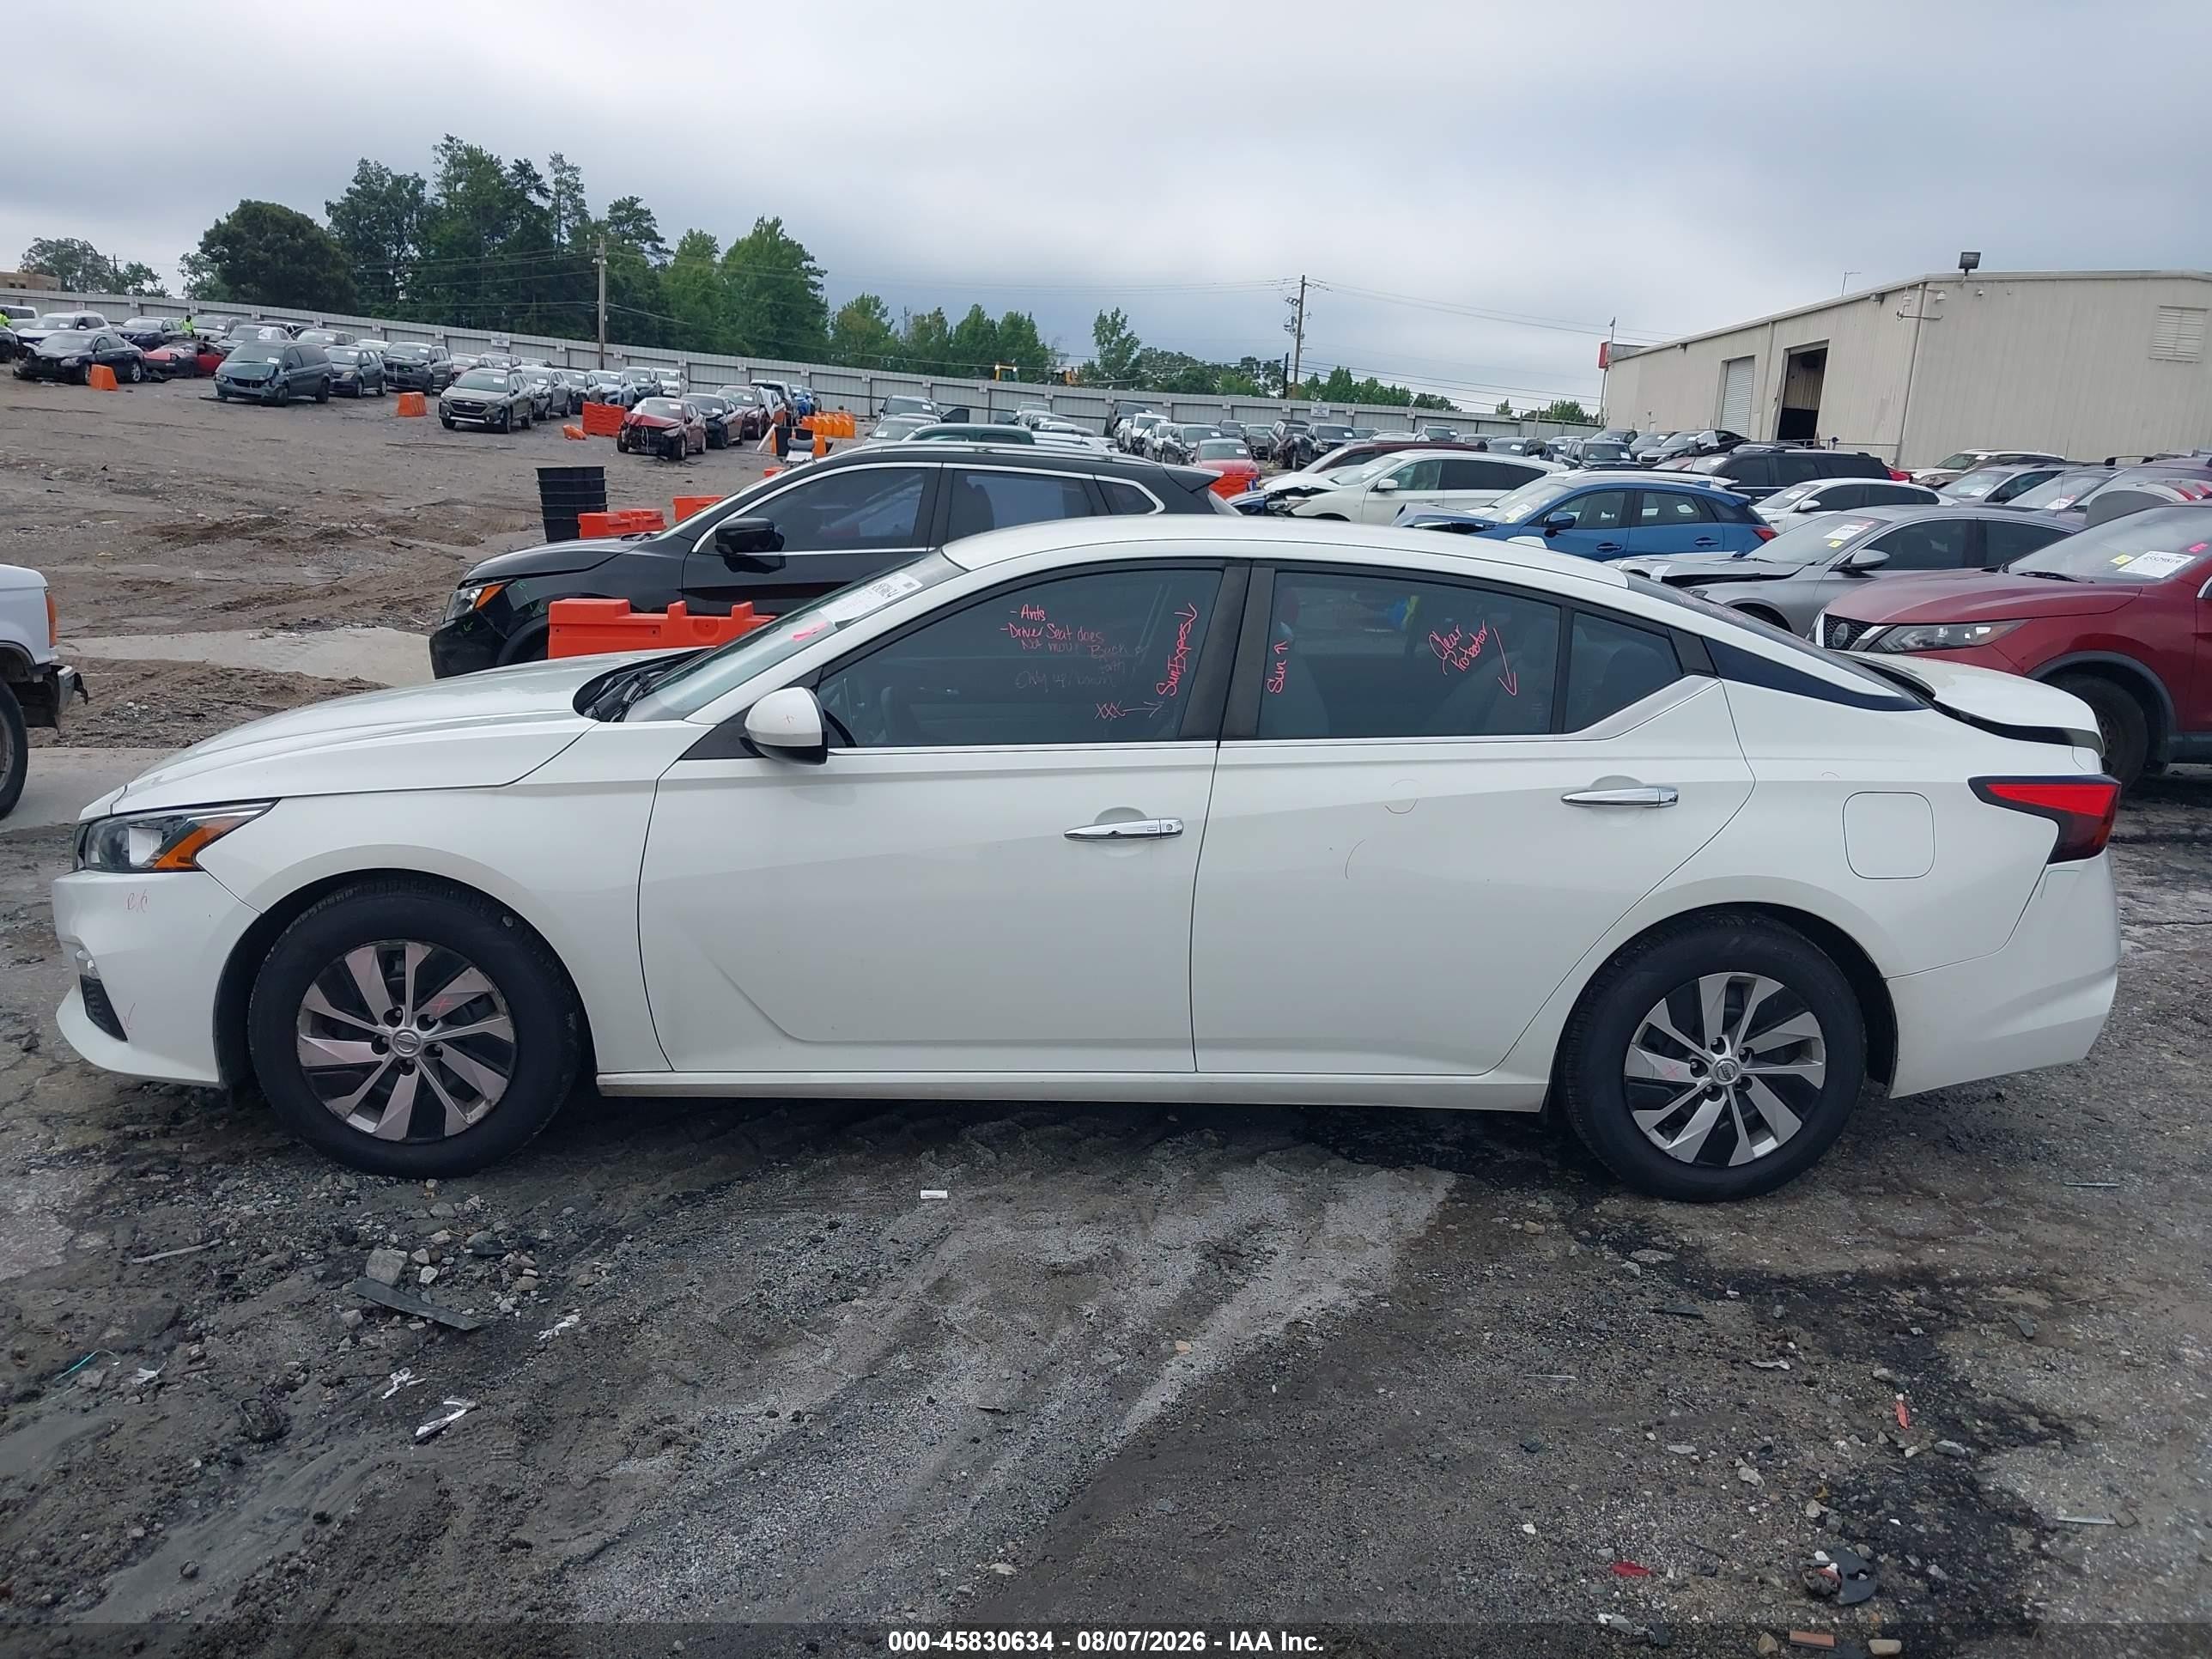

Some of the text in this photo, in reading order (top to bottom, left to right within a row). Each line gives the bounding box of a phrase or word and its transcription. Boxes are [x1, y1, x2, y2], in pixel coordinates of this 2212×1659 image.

[1020, 604, 1046, 621] Ants
[1046, 623, 1073, 640] Seat
[1077, 625, 1105, 644] does
[1267, 659, 1288, 694] Sun
